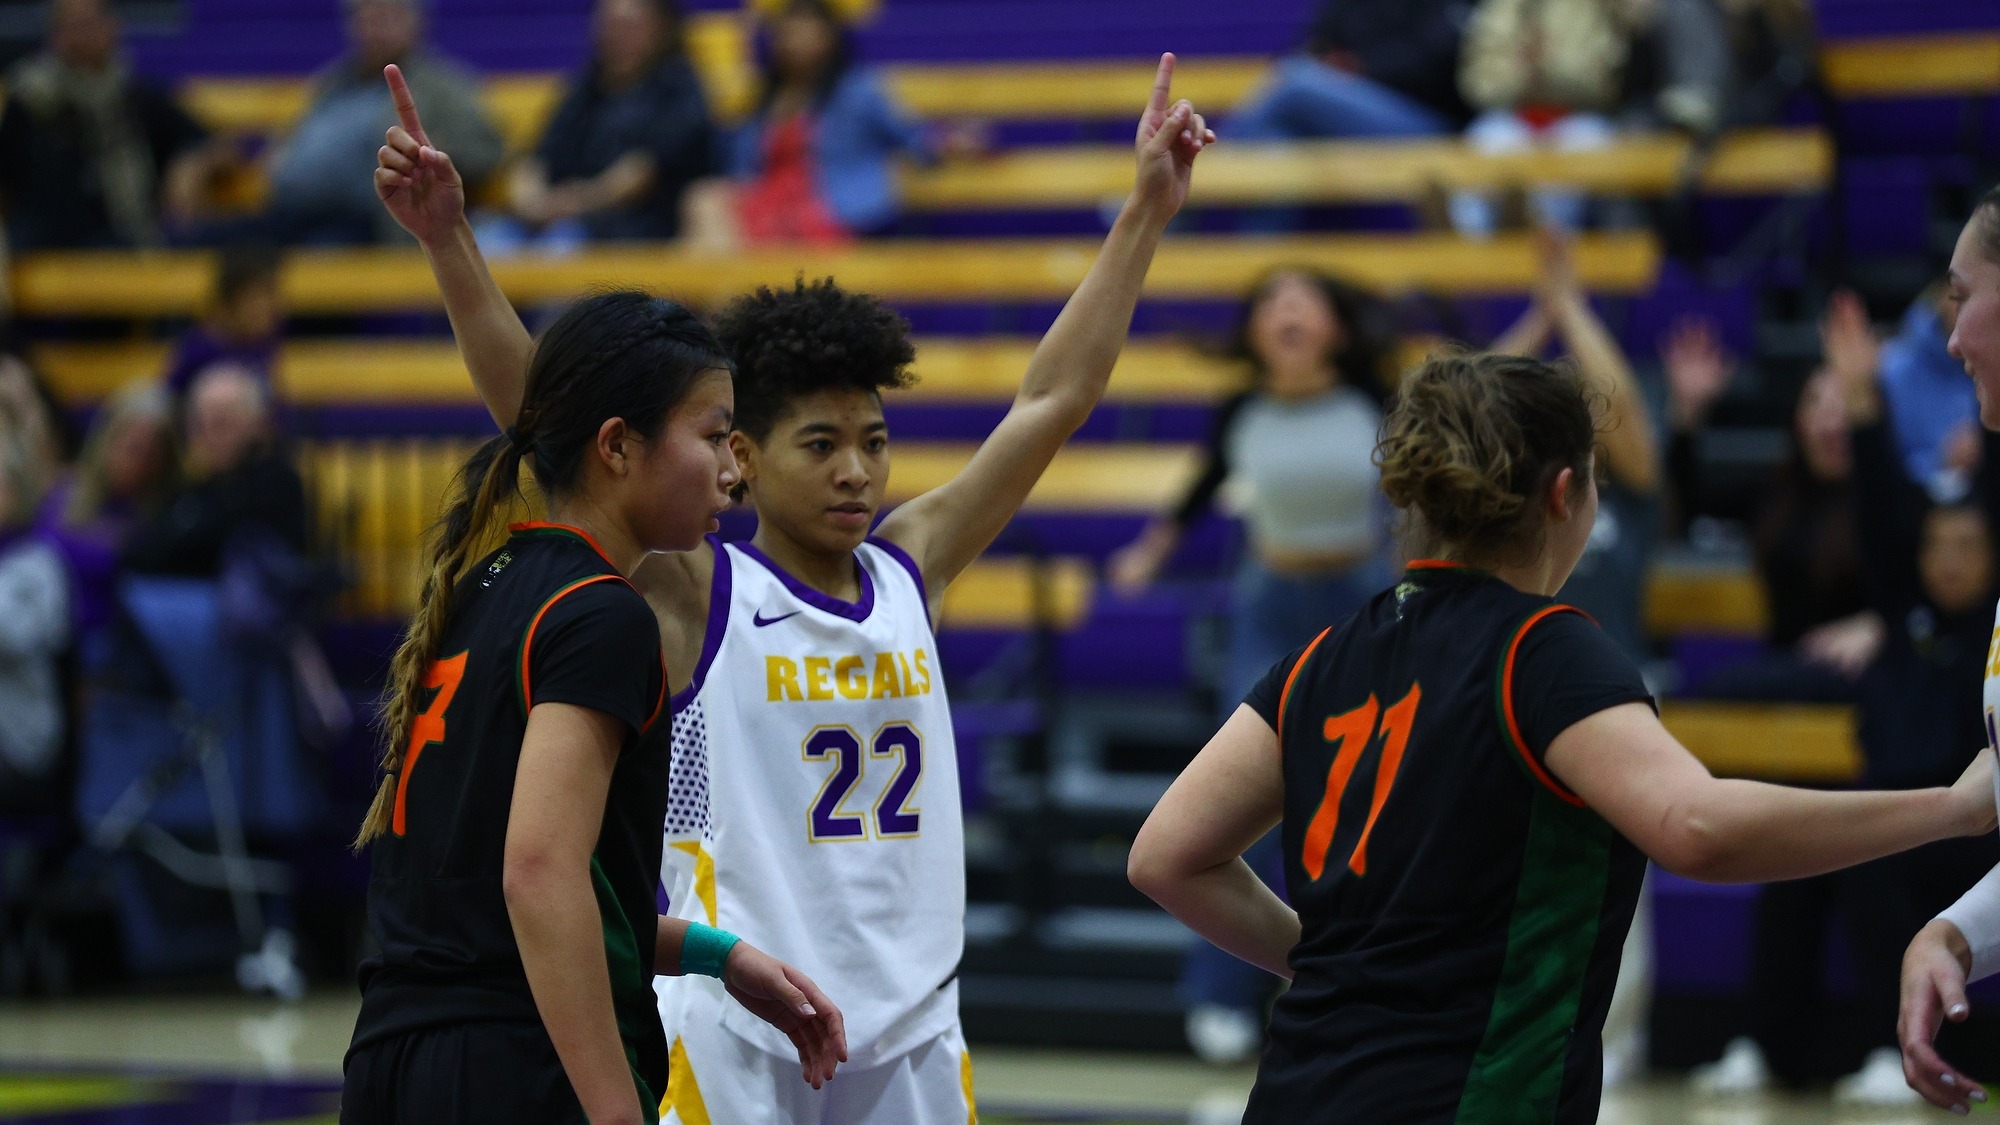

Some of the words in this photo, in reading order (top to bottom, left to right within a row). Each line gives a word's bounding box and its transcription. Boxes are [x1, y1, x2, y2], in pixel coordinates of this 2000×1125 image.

[765, 648, 931, 702] REGALS
[802, 720, 924, 843] 22
[1302, 680, 1421, 881] 11
